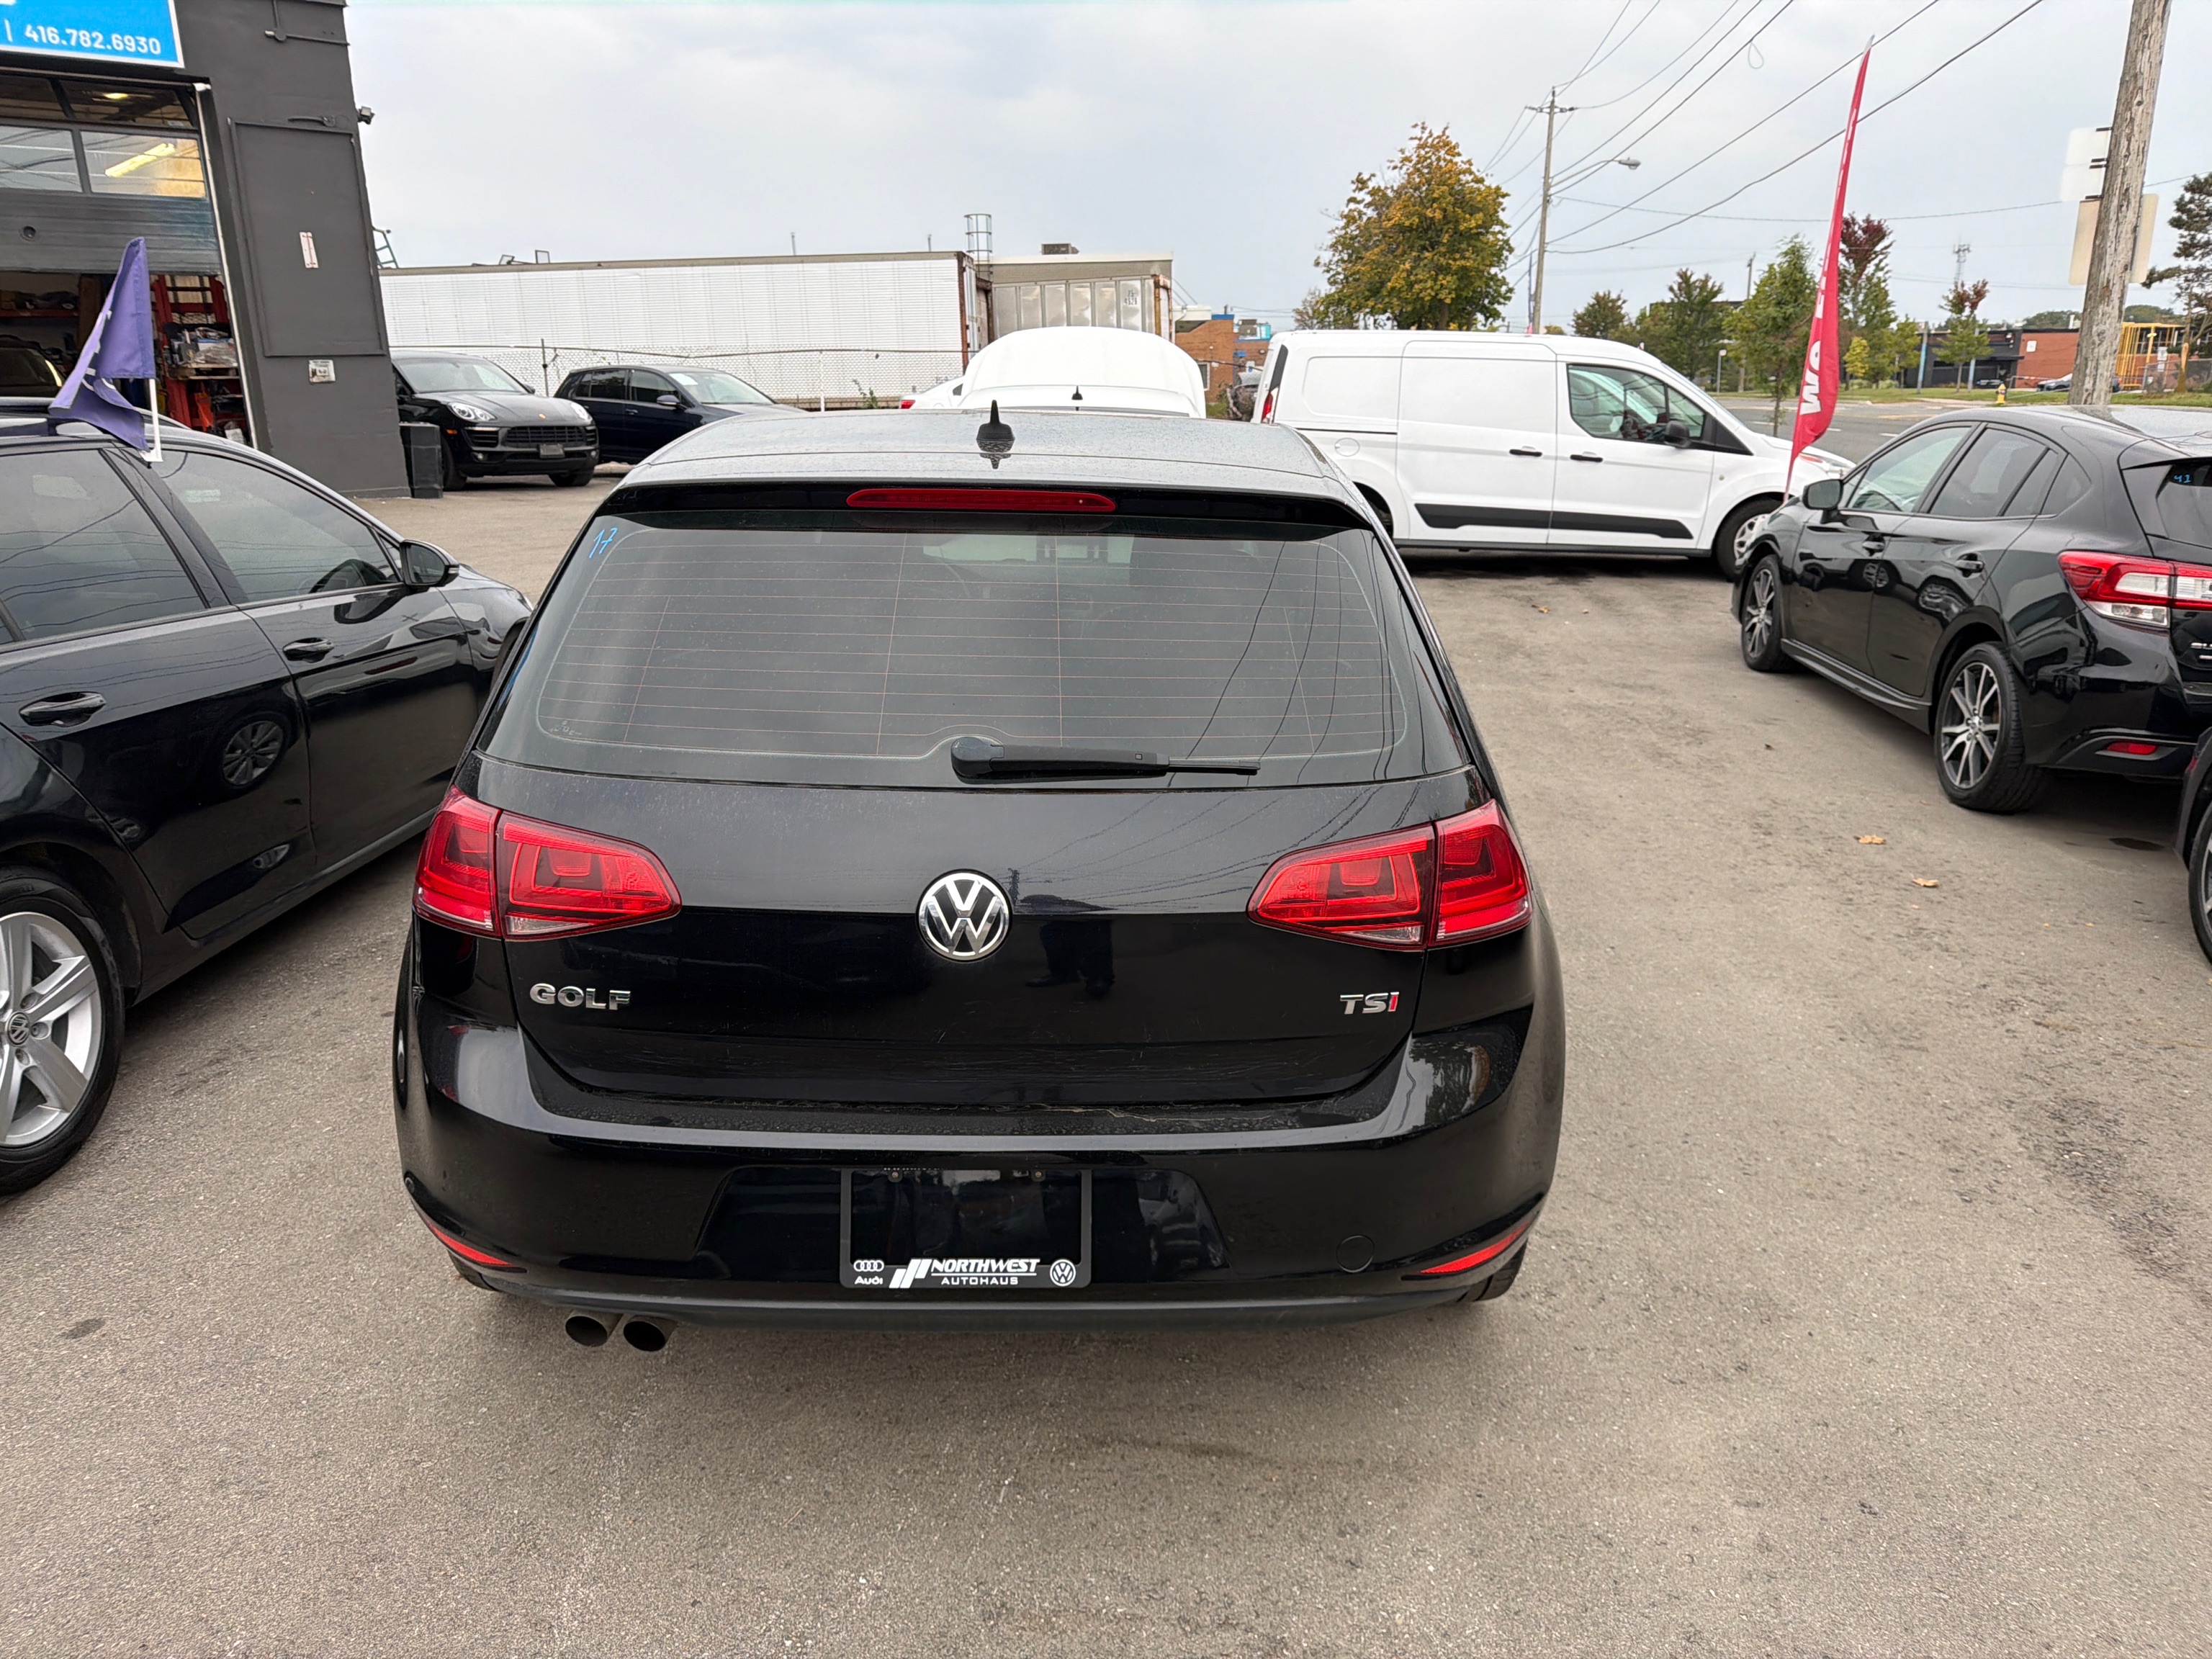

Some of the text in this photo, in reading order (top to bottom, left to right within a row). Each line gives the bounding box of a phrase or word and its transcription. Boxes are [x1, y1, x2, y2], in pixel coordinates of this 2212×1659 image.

[24, 24, 161, 55] 416.782.6930
[588, 526, 619, 559] 17
[529, 982, 631, 1011] GOLF
[1339, 992, 1400, 1015] TSI
[931, 1259, 1040, 1272] NORTHWEST
[854, 1275, 884, 1285] Audi
[940, 1277, 1019, 1286] AUTOHAUS
